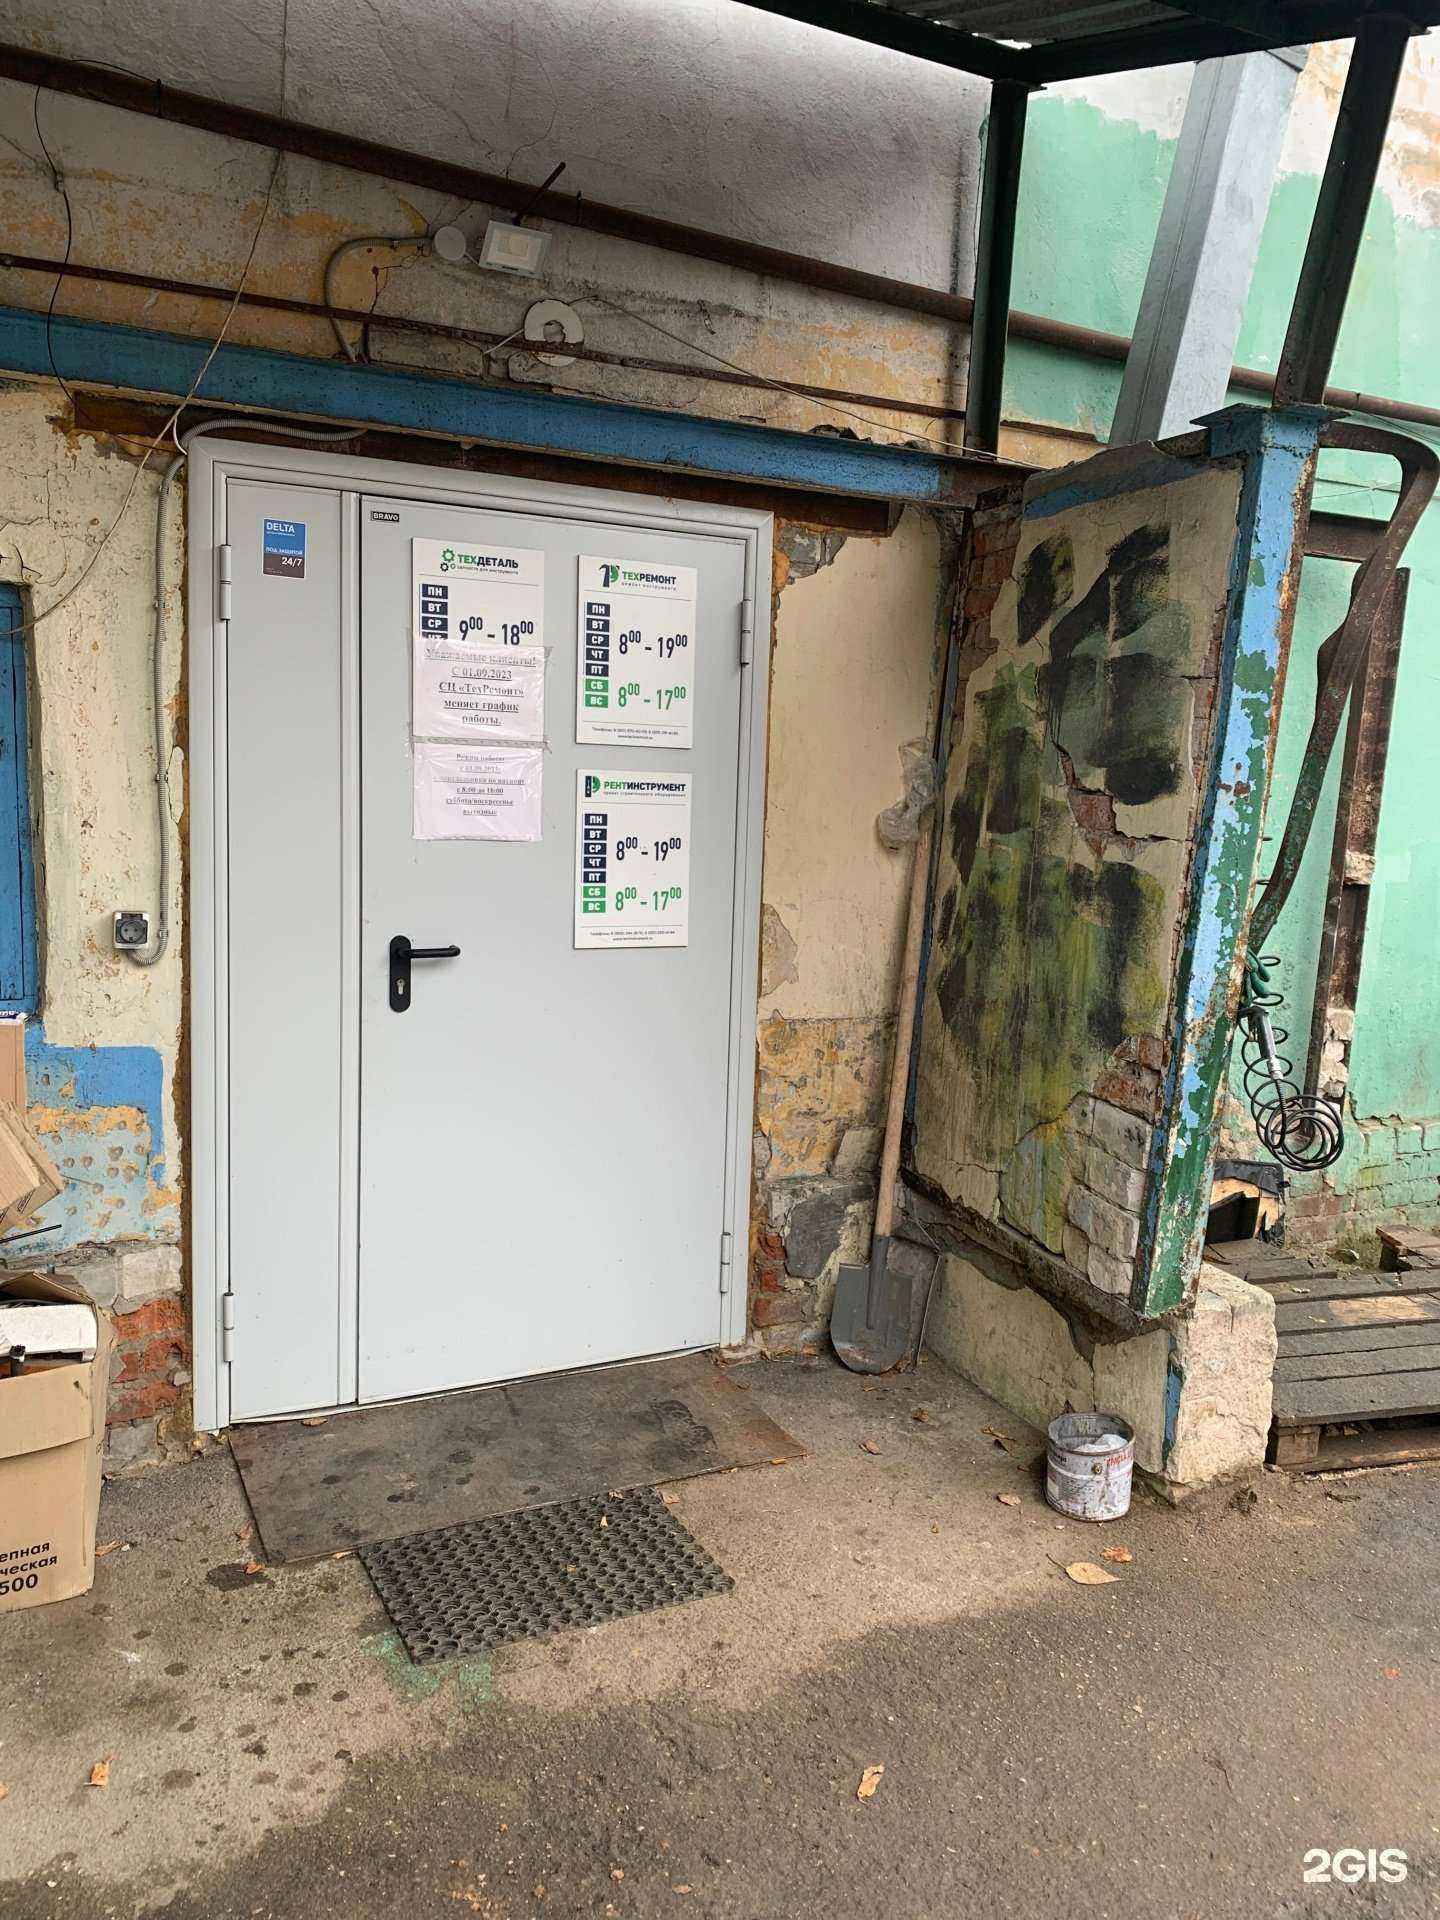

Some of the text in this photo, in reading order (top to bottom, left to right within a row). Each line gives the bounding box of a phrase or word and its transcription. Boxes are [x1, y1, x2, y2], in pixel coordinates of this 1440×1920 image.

[373, 512, 399, 521] BRAVO
[266, 522, 295, 533] DELTA
[281, 556, 303, 568] 24/7
[457, 554, 519, 568] ТЕХДЕТАЛЬ
[622, 571, 677, 585] ТЕХРЕМОНТ
[427, 586, 443, 597] ПН
[428, 603, 442, 613] ВТ
[591, 604, 606, 615] ПН
[428, 619, 442, 629] СР
[591, 620, 604, 630] ВТ
[591, 635, 604, 645] СР
[591, 650, 604, 659] ЧТ
[462, 667, 512, 680] 01.09.2023
[591, 665, 604, 675] ПТ
[590, 681, 604, 690] СБ
[444, 700, 519, 712] меняет график
[590, 697, 603, 705] ВС
[604, 781, 687, 792] РЕНТИНСТРУМЕНТ
[589, 815, 603, 825] ПН
[589, 830, 602, 839] ВТ
[589, 844, 602, 853] СР
[588, 858, 601, 867] ЧТ
[588, 873, 601, 882] ПТ
[588, 887, 601, 896] СБ
[588, 902, 601, 911] ВС
